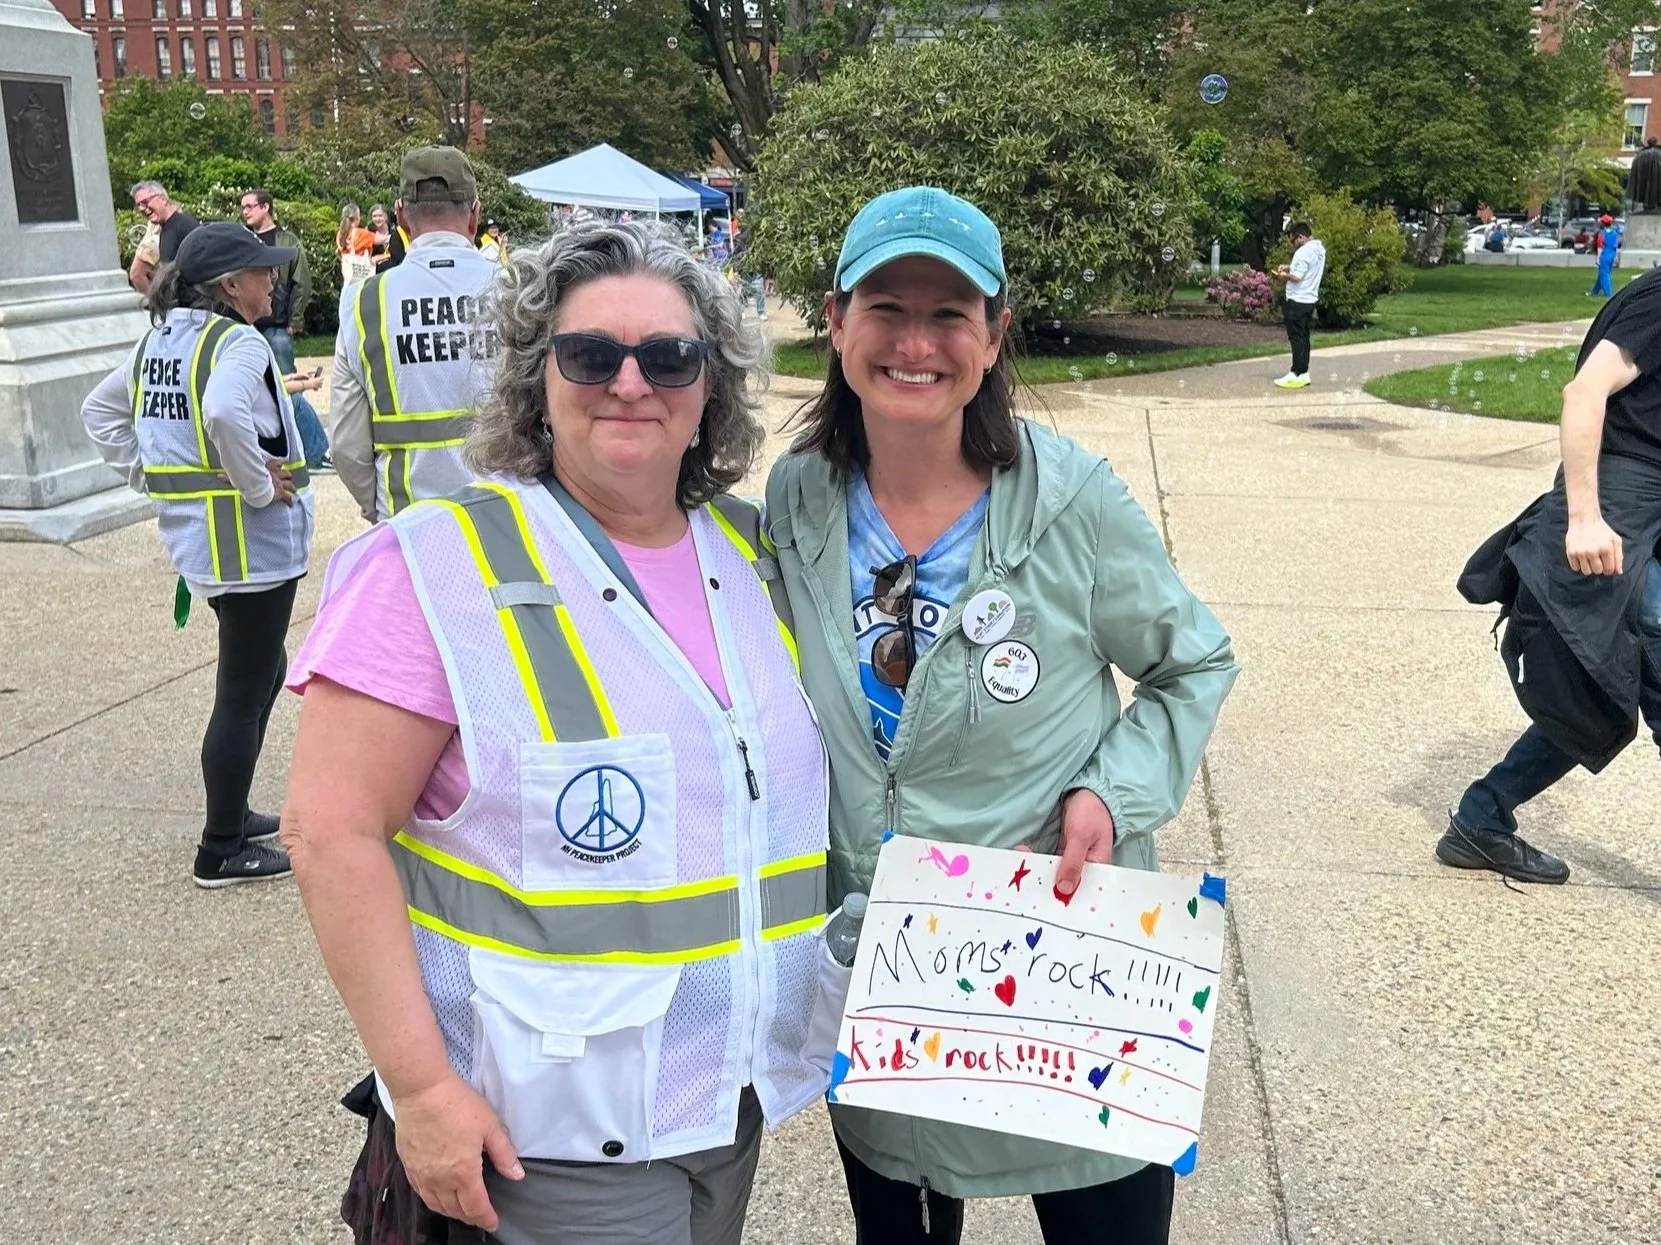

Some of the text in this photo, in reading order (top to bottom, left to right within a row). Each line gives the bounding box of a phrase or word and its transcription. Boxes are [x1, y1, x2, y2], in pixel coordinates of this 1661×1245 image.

[1008, 647, 1028, 661] 603
[987, 676, 1020, 698] Equality
[560, 838, 642, 864] NH PEACEKEEPER PROJECT
[868, 928, 1003, 997] Moms
